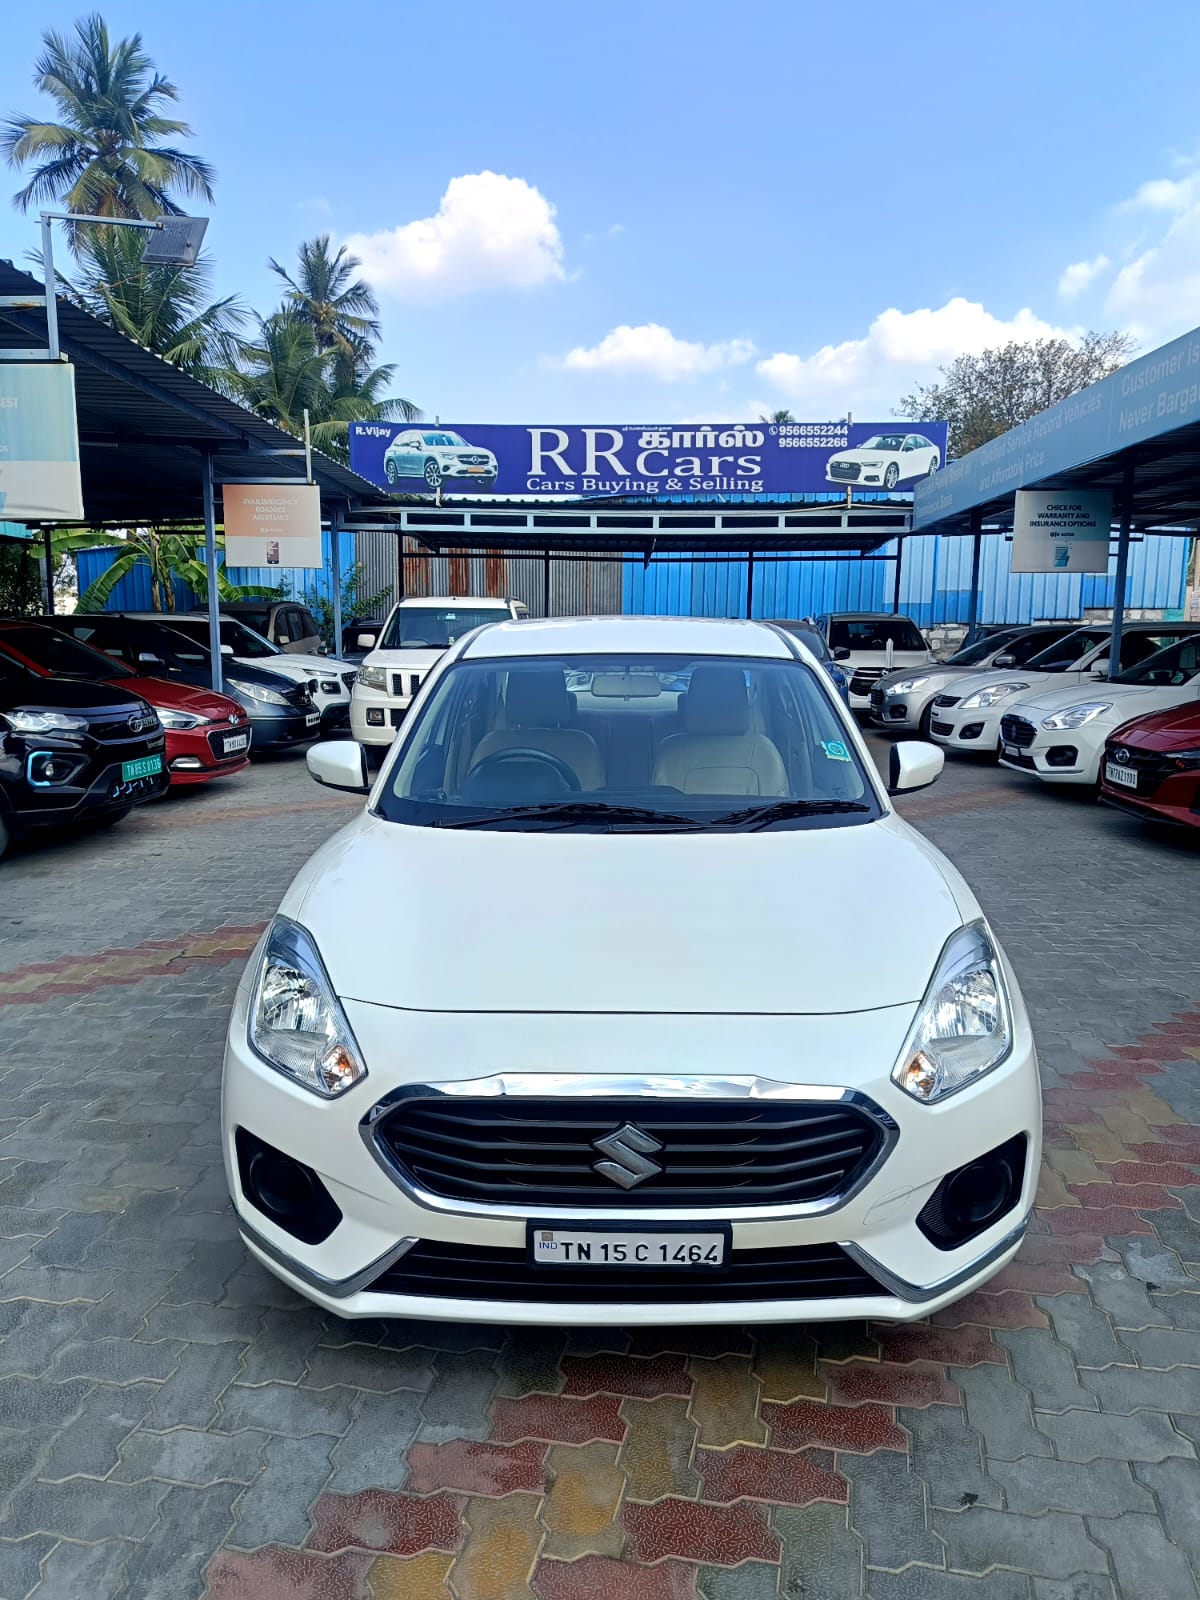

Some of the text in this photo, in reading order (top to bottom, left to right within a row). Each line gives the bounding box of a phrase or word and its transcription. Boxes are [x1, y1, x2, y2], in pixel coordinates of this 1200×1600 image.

[1121, 351, 1185, 397] Customer
[1034, 409, 1062, 440] Record
[1064, 392, 1102, 425] Vehicles
[1119, 402, 1154, 432] Never
[355, 427, 391, 437] R.Vijay
[638, 425, 765, 449] கார்ஸ்
[779, 425, 848, 436] 9566552244
[526, 428, 761, 477] RR Cars
[779, 437, 848, 448] 9566552266
[1025, 449, 1045, 472] Price
[526, 477, 764, 493] Cars Buying & Selling
[539, 1241, 558, 1250] IND
[561, 1243, 718, 1262] TN 15 C 1464
